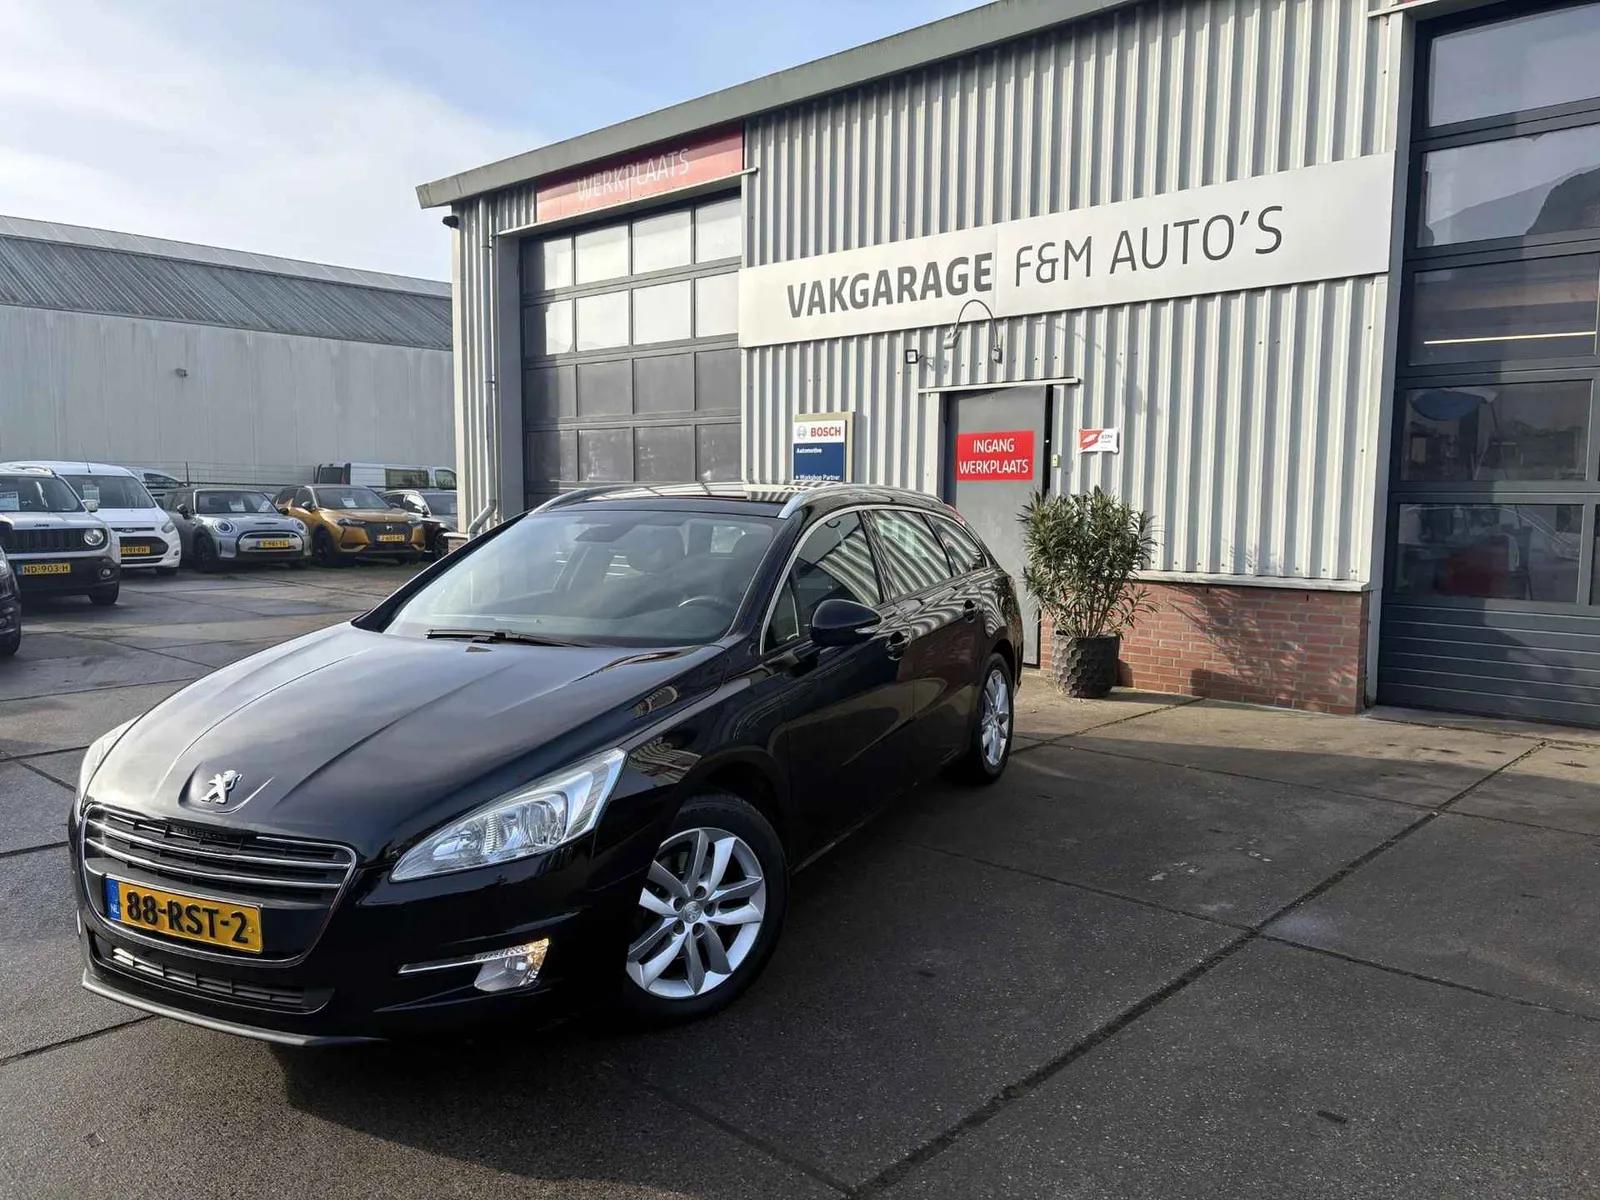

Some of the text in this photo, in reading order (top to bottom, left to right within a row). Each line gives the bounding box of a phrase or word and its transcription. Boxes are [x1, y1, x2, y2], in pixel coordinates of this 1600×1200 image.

[576, 148, 690, 202] WERKPLAATS
[787, 205, 1283, 318] VAKGARAGE F&M AUTO'S
[810, 426, 842, 437] BOSCH
[973, 438, 1015, 453] INGANG
[959, 459, 1029, 474] WERKPLAATS
[127, 890, 249, 944] 88-RST-2
